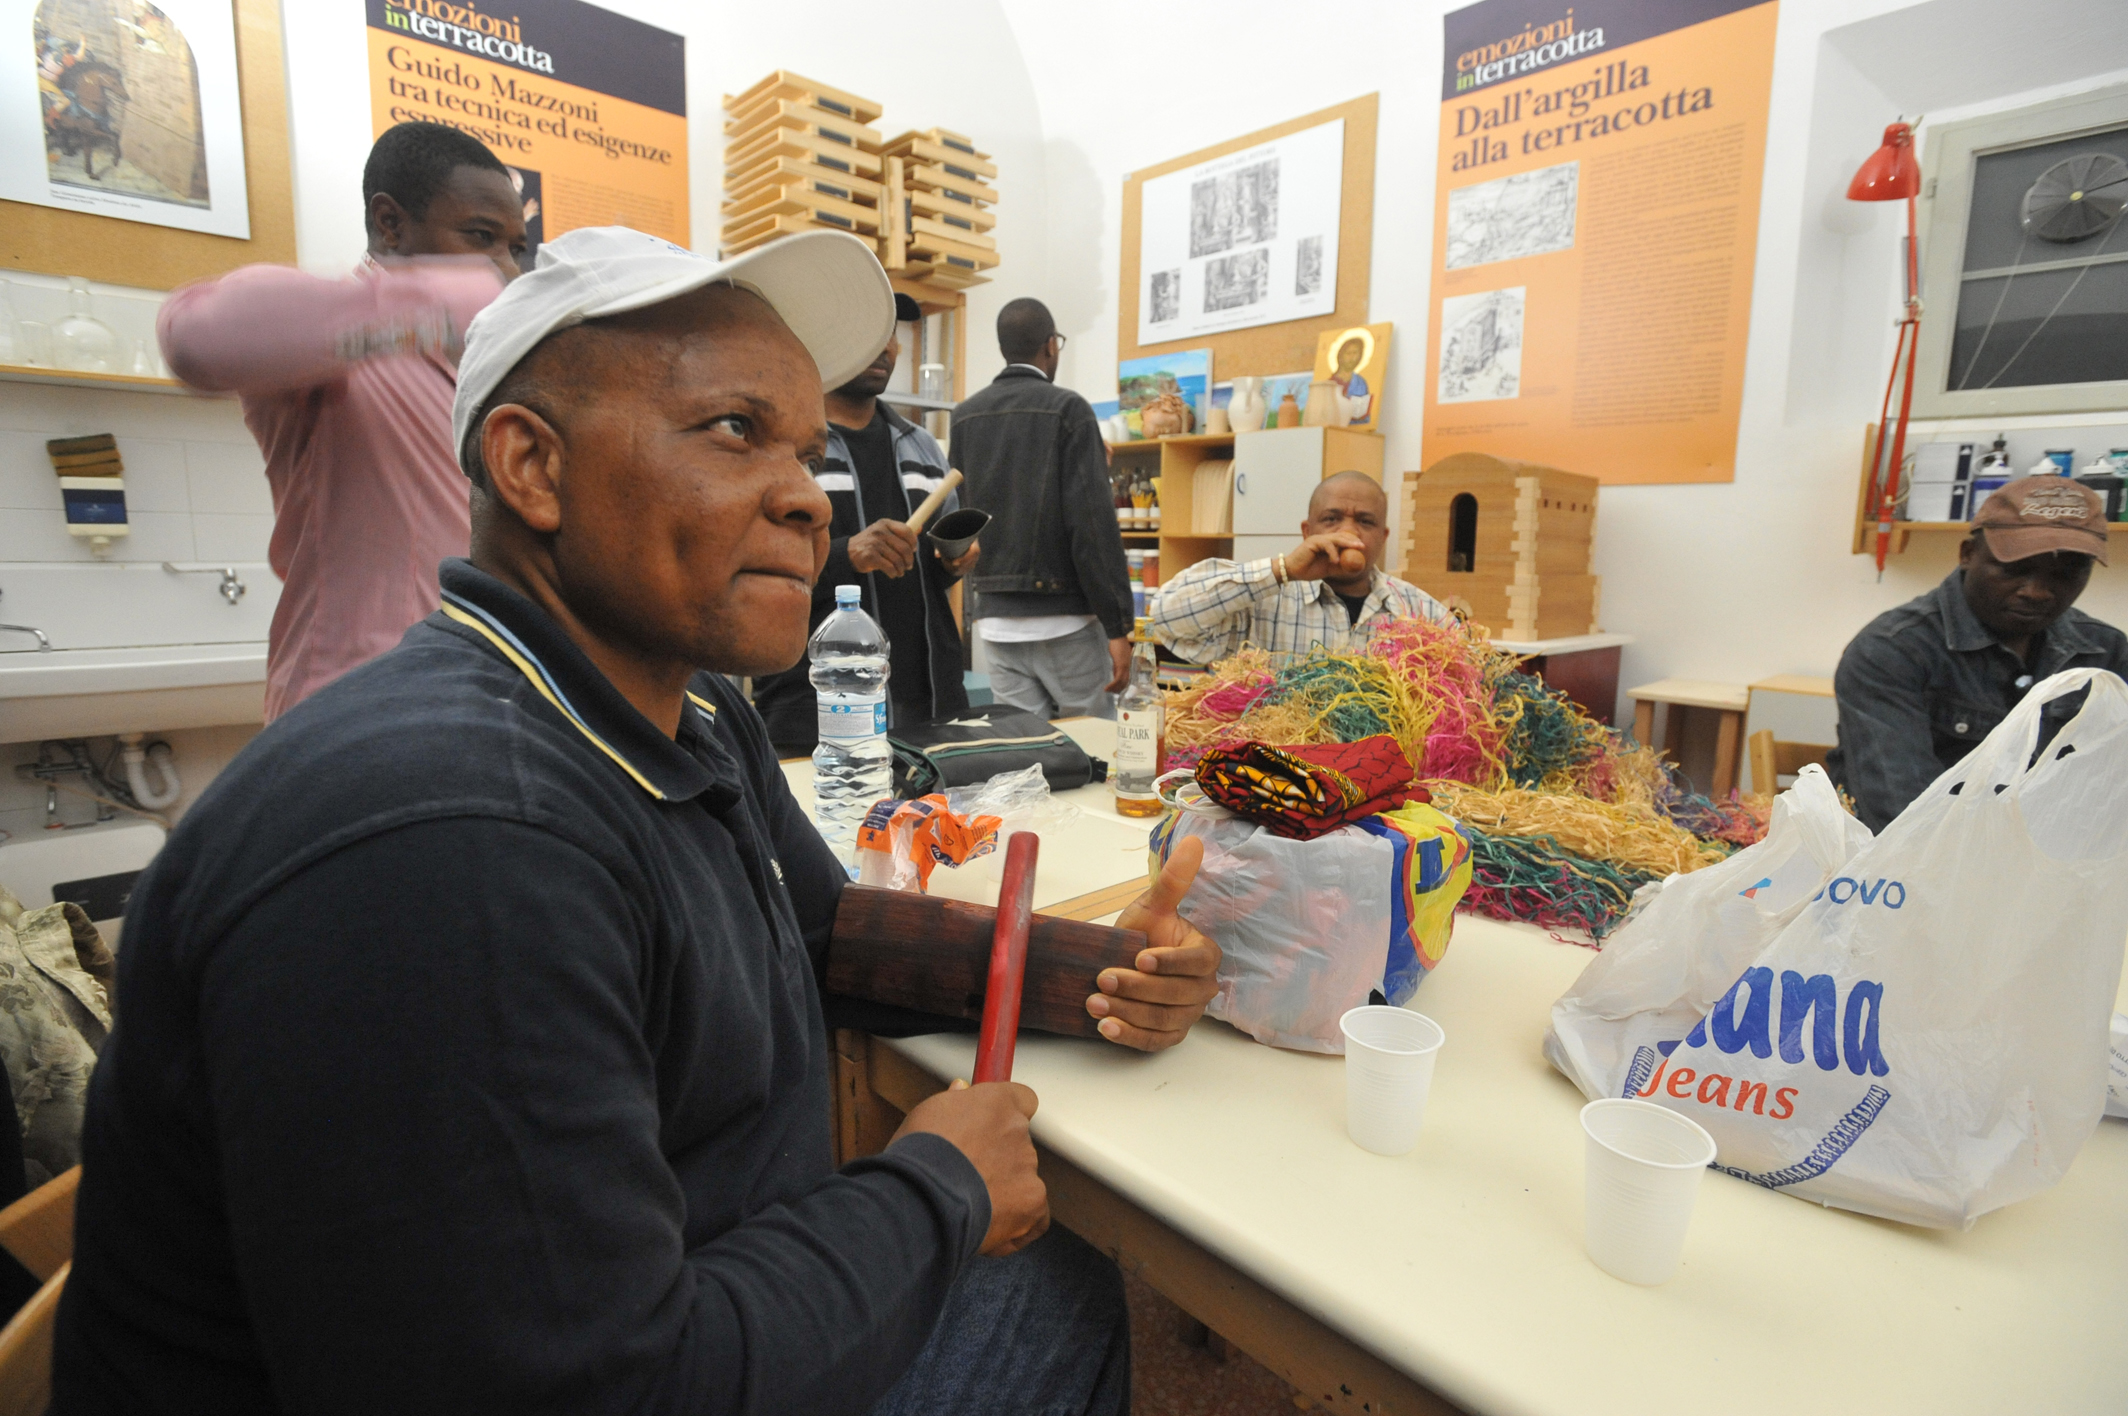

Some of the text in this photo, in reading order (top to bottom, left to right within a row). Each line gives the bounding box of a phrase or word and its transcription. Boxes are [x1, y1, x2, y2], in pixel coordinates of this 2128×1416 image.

[1457, 8, 1574, 73] emozioni
[387, 46, 600, 124] Guido Mazzoni
[389, 76, 672, 165] tra tecnica ed esigenze
[1454, 61, 1651, 138] Dall'argilla
[1452, 87, 1714, 172] alla terracotta
[1129, 728, 1150, 740] PARK
